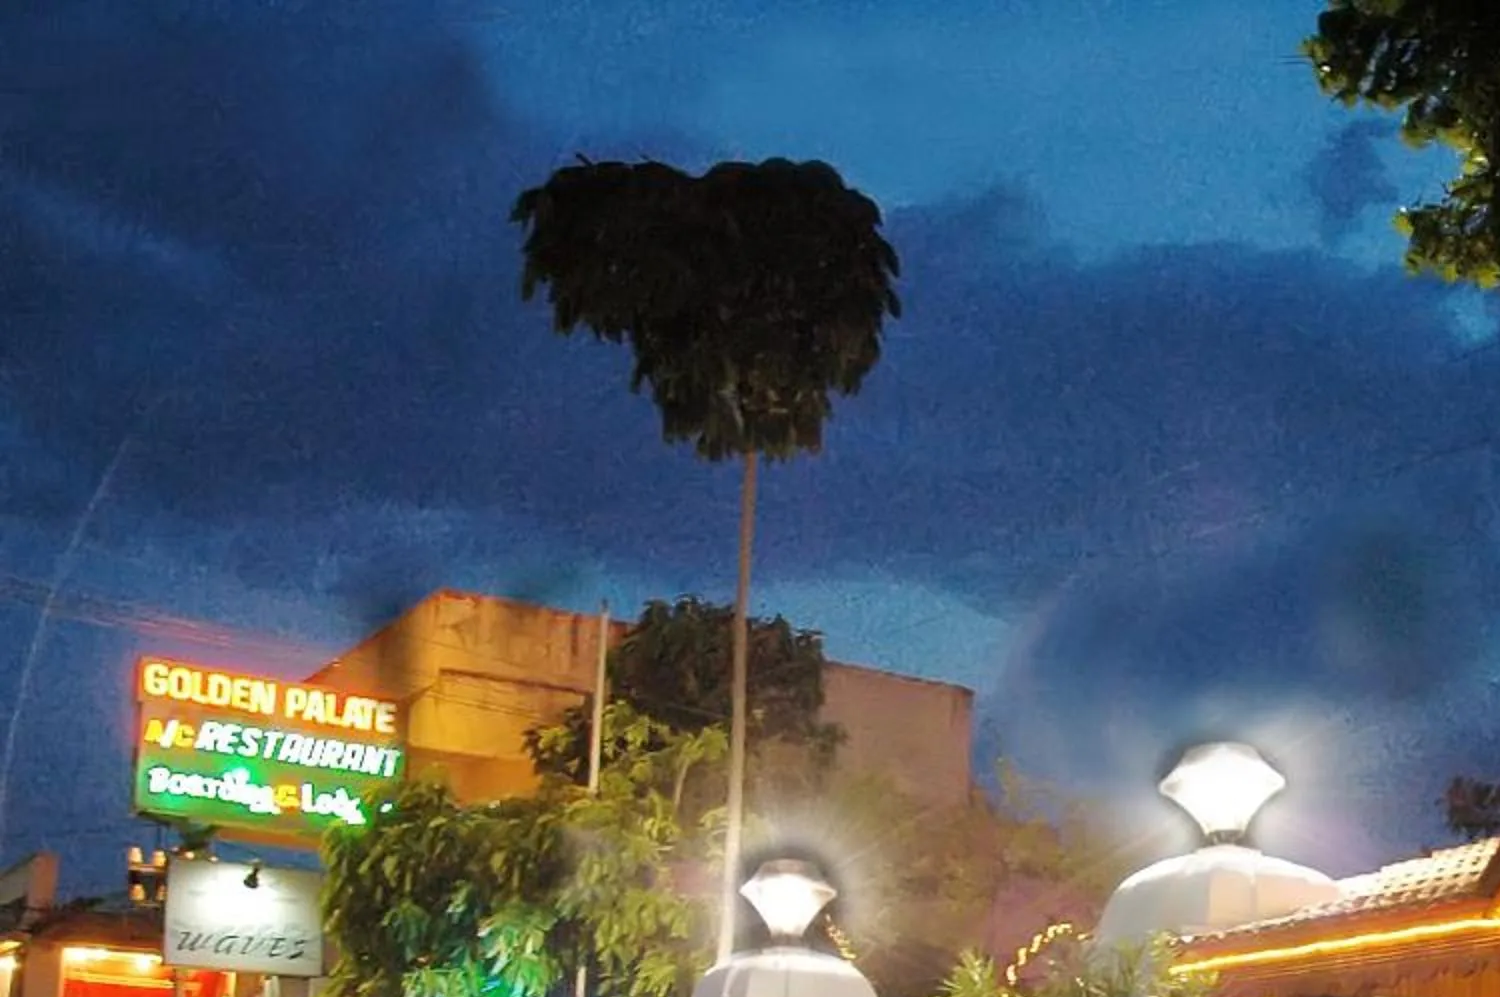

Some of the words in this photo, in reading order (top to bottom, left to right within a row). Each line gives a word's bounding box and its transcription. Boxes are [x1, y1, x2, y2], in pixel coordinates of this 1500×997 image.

[143, 661, 277, 717] GOLDEN
[283, 686, 398, 734] PALATE
[194, 720, 402, 778] RESTAURANT
